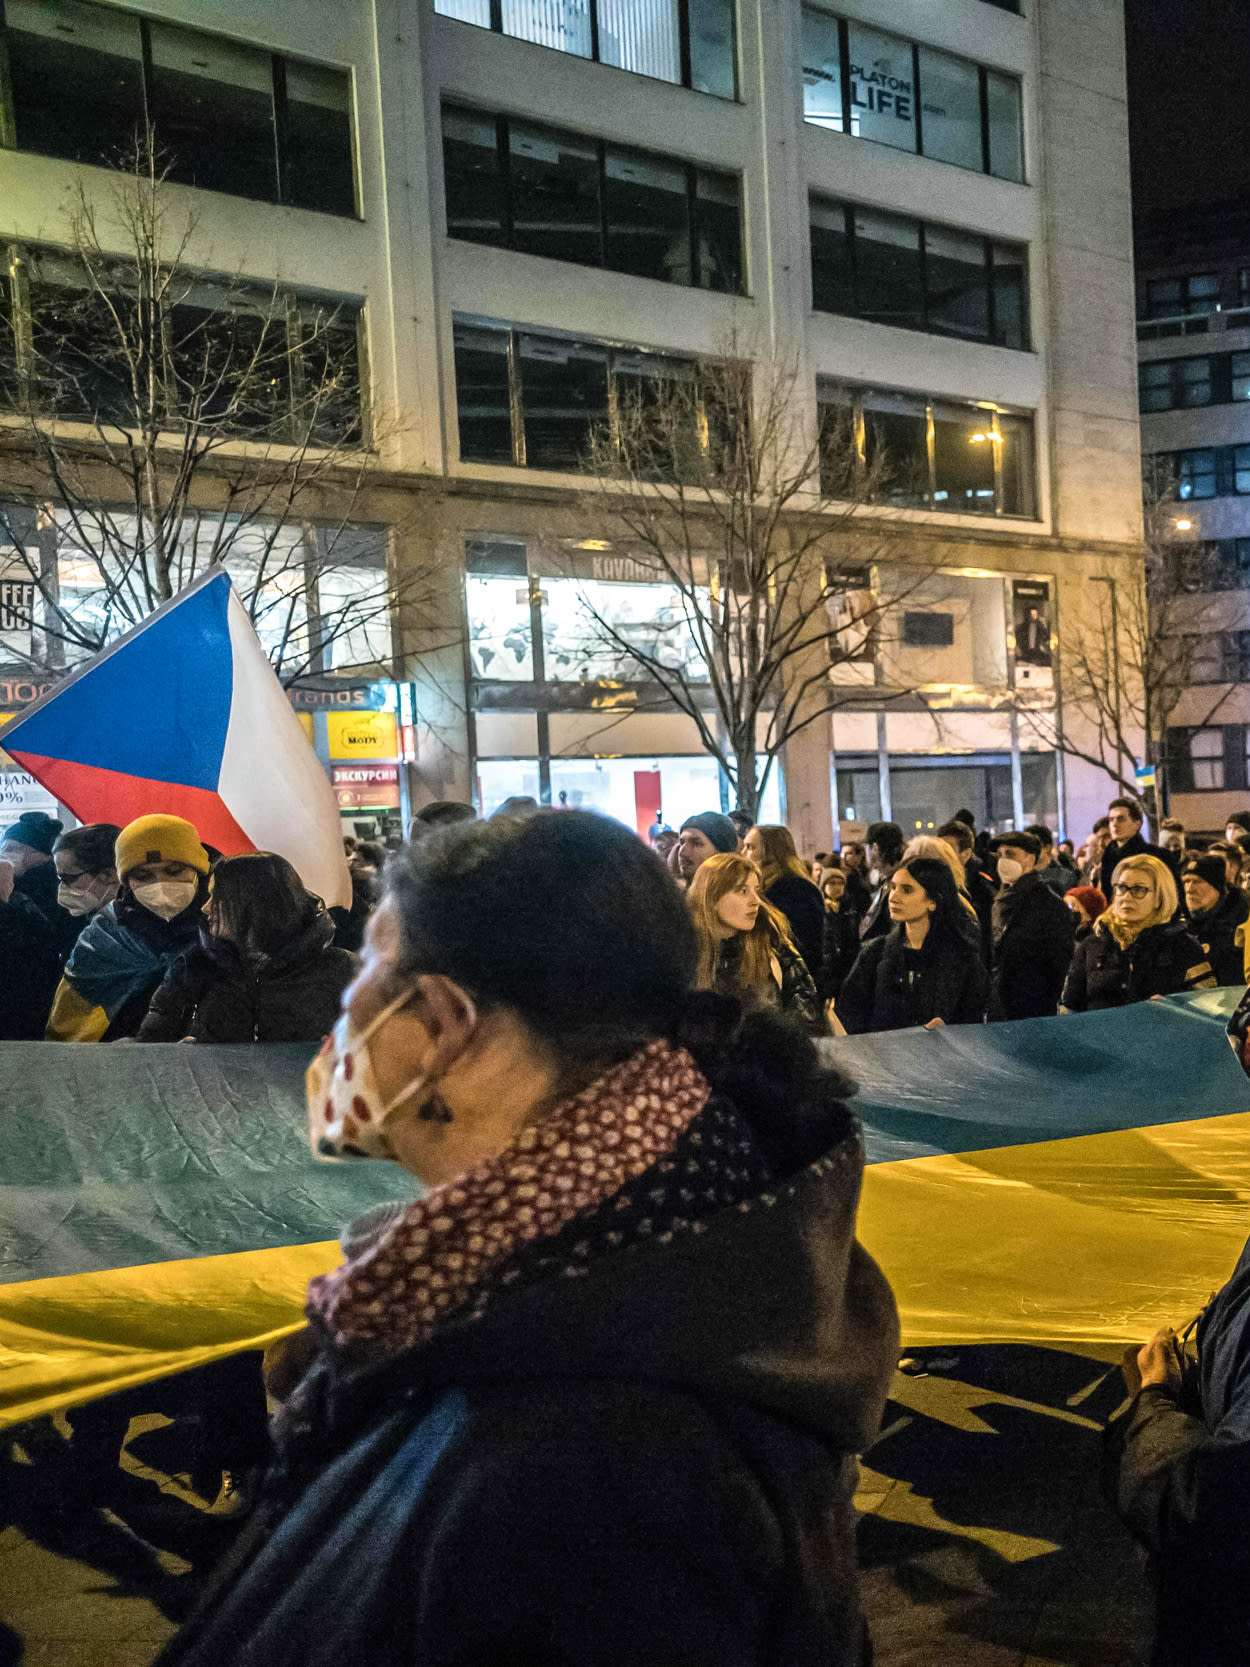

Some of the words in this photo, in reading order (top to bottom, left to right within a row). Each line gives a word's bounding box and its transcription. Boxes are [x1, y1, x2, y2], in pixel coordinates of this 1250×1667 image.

[850, 64, 911, 95] PLATON
[851, 81, 912, 121] LIFE
[334, 769, 398, 783] ЭКСКУРСИИ
